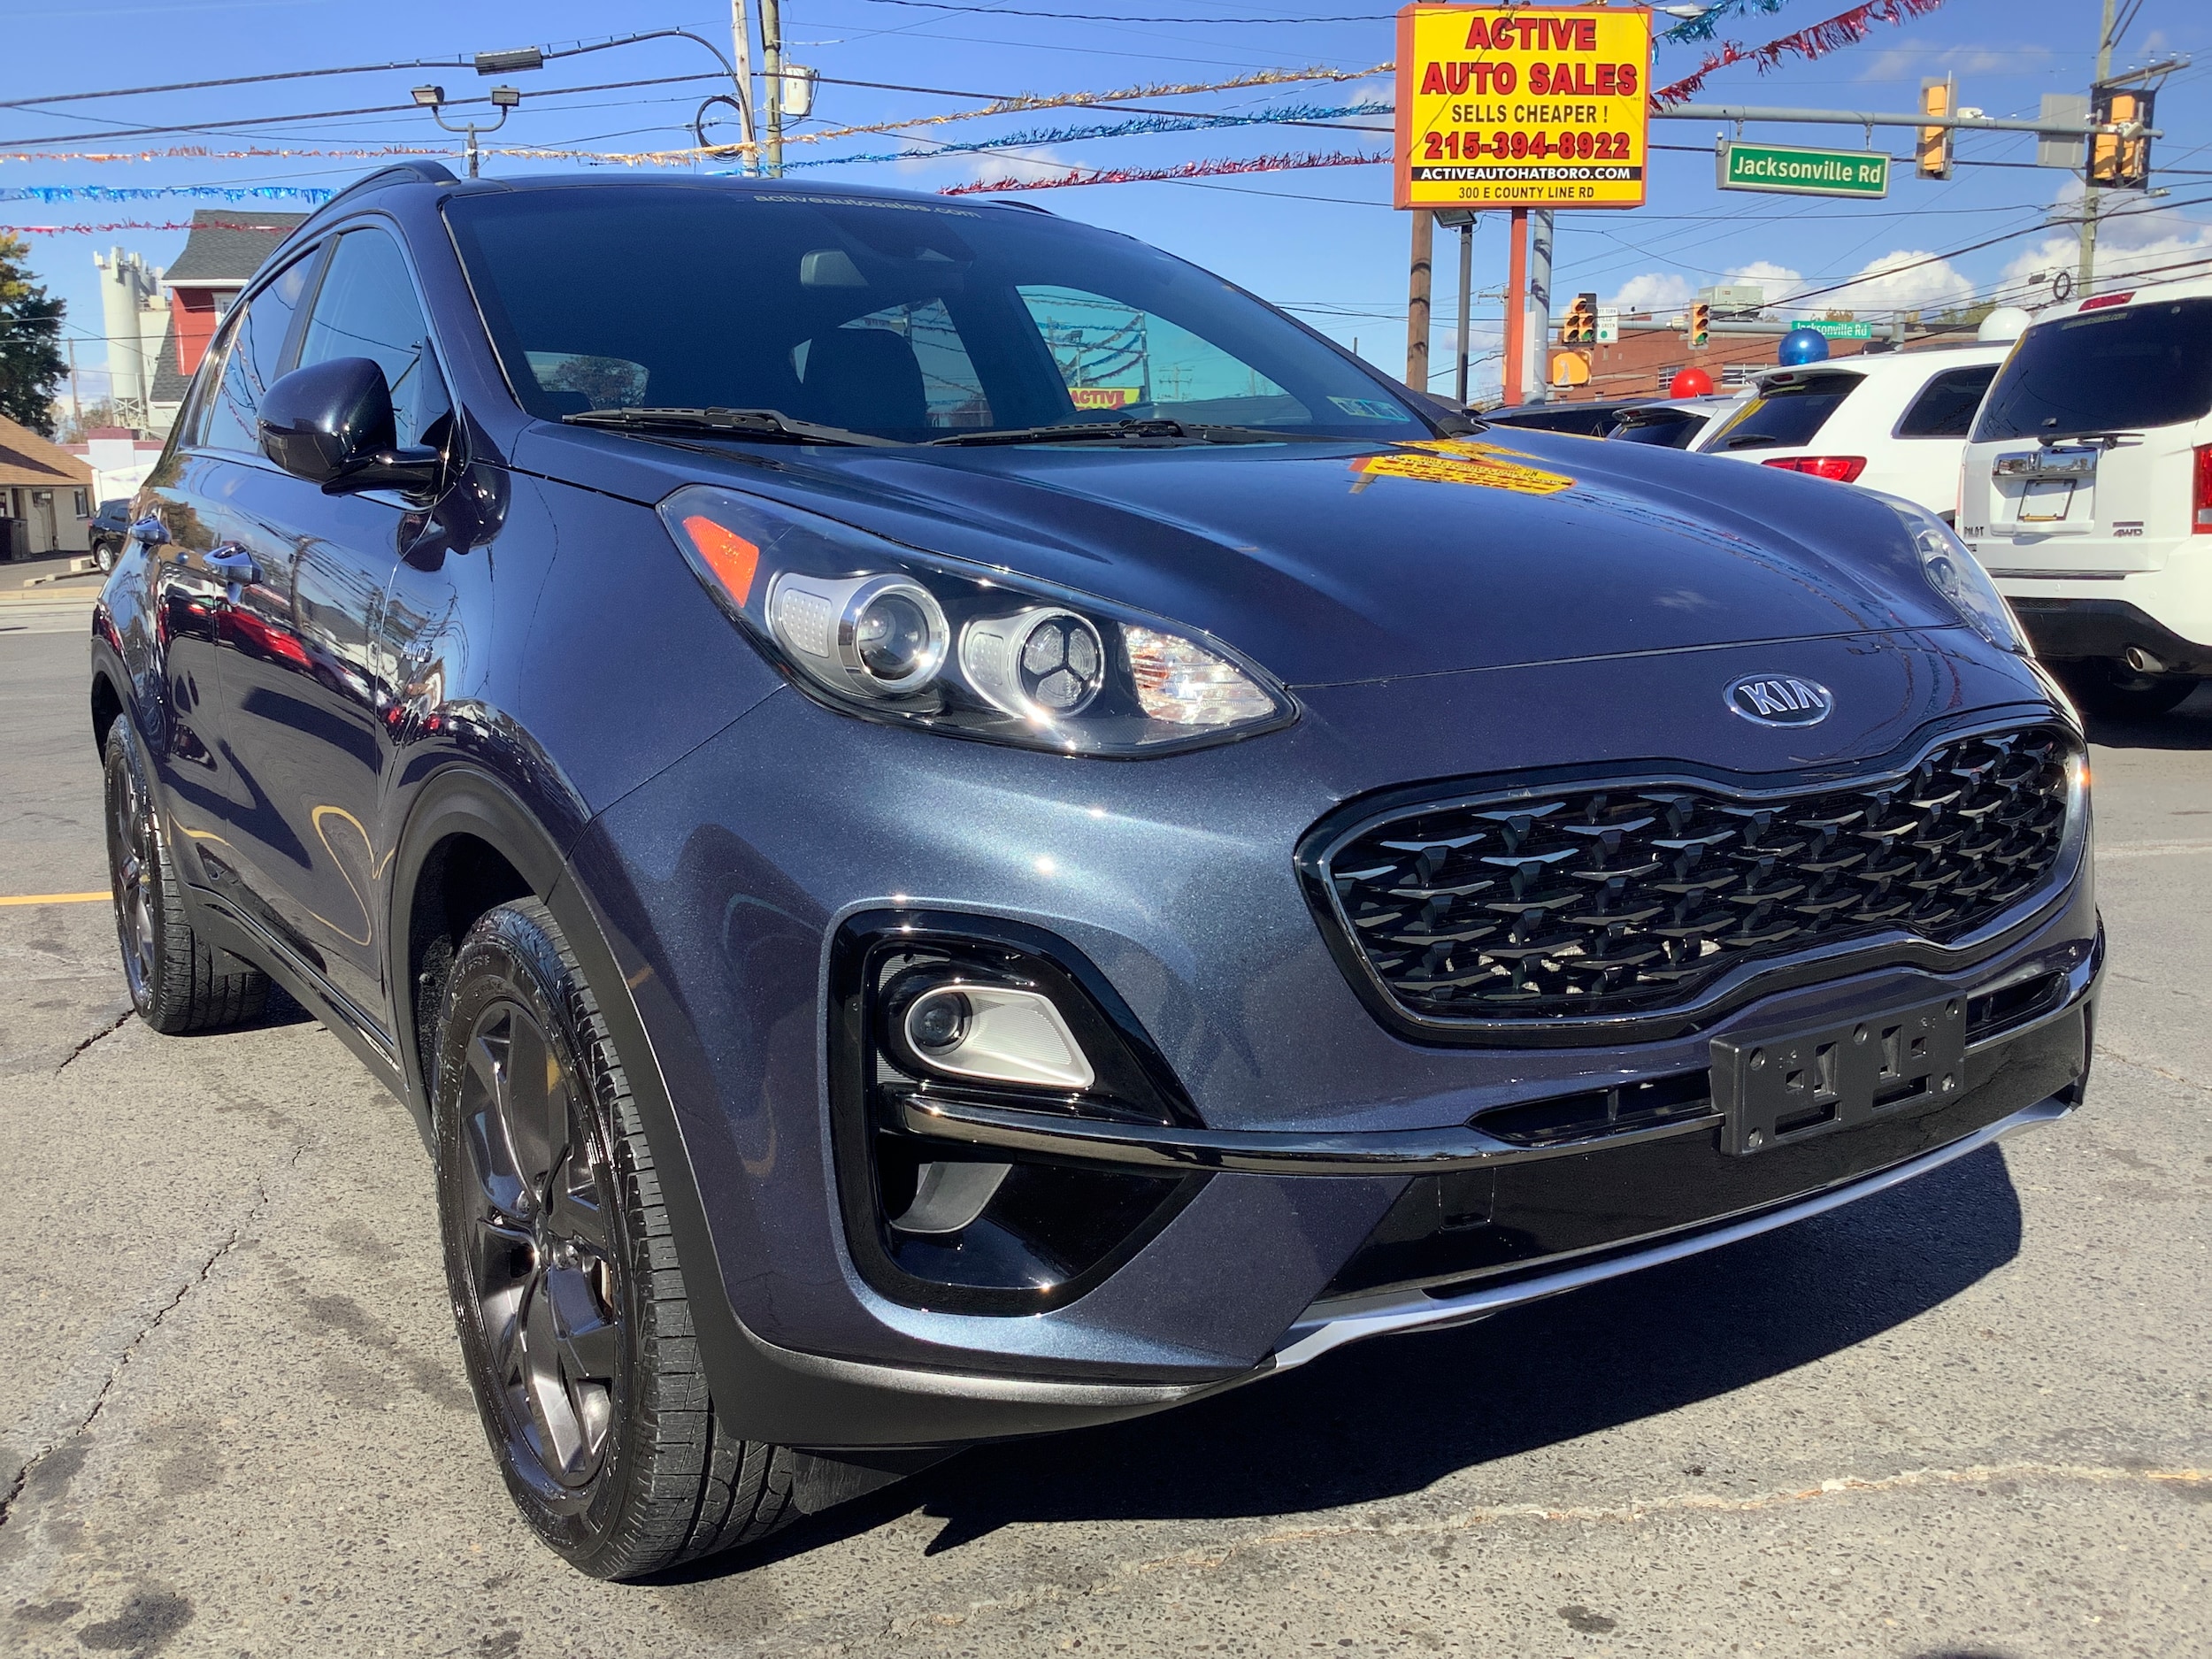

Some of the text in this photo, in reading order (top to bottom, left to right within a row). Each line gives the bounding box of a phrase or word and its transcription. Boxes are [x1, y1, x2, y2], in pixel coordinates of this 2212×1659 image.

[1465, 17, 1596, 50] ACTIVE
[1420, 62, 1637, 96] AUTO SALES
[1452, 104, 1507, 122] SELLS
[1514, 104, 1597, 123] CHEAPER
[1425, 131, 1630, 159] 215-394-8922
[1420, 167, 1631, 180] ACTIVEAUTOHATBORO.COM
[1734, 156, 1881, 184] Jacksonville Rd
[1459, 187, 1594, 198] 300 E COUNTY LINE RD
[753, 193, 982, 219] activeautosales.com
[1855, 324, 1867, 336] Rd
[1071, 390, 1125, 404] ACTIVE
[1739, 680, 1824, 715] KIA
